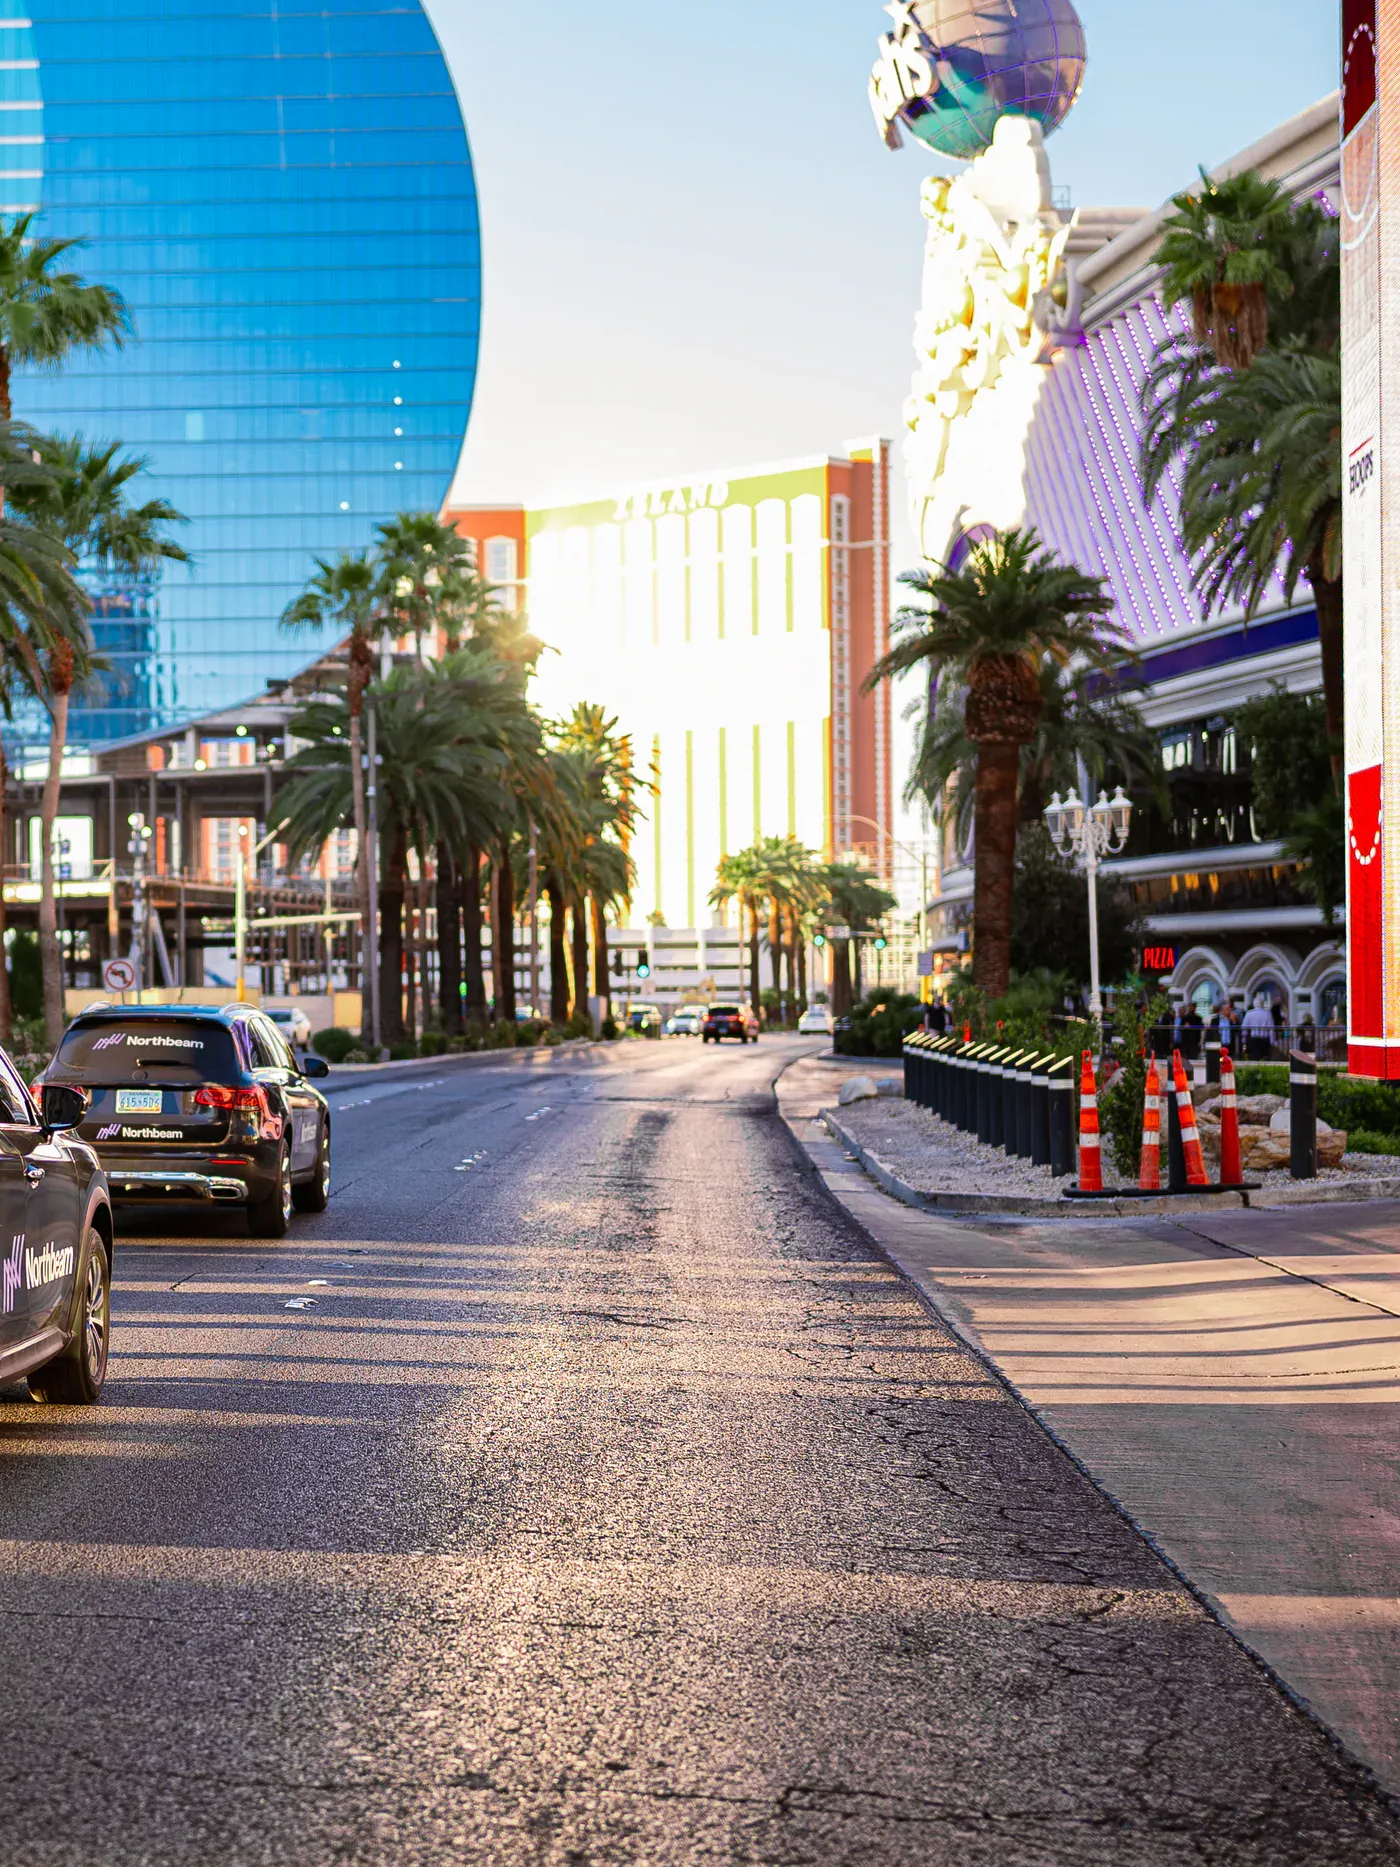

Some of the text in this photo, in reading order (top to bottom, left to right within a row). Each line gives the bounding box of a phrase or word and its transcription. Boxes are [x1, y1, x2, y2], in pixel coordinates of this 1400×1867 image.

[1143, 947, 1175, 969] PIZZA
[126, 1036, 204, 1049] Northbeam
[122, 1127, 183, 1139] Northbeam
[25, 1241, 74, 1290] Northbeam
